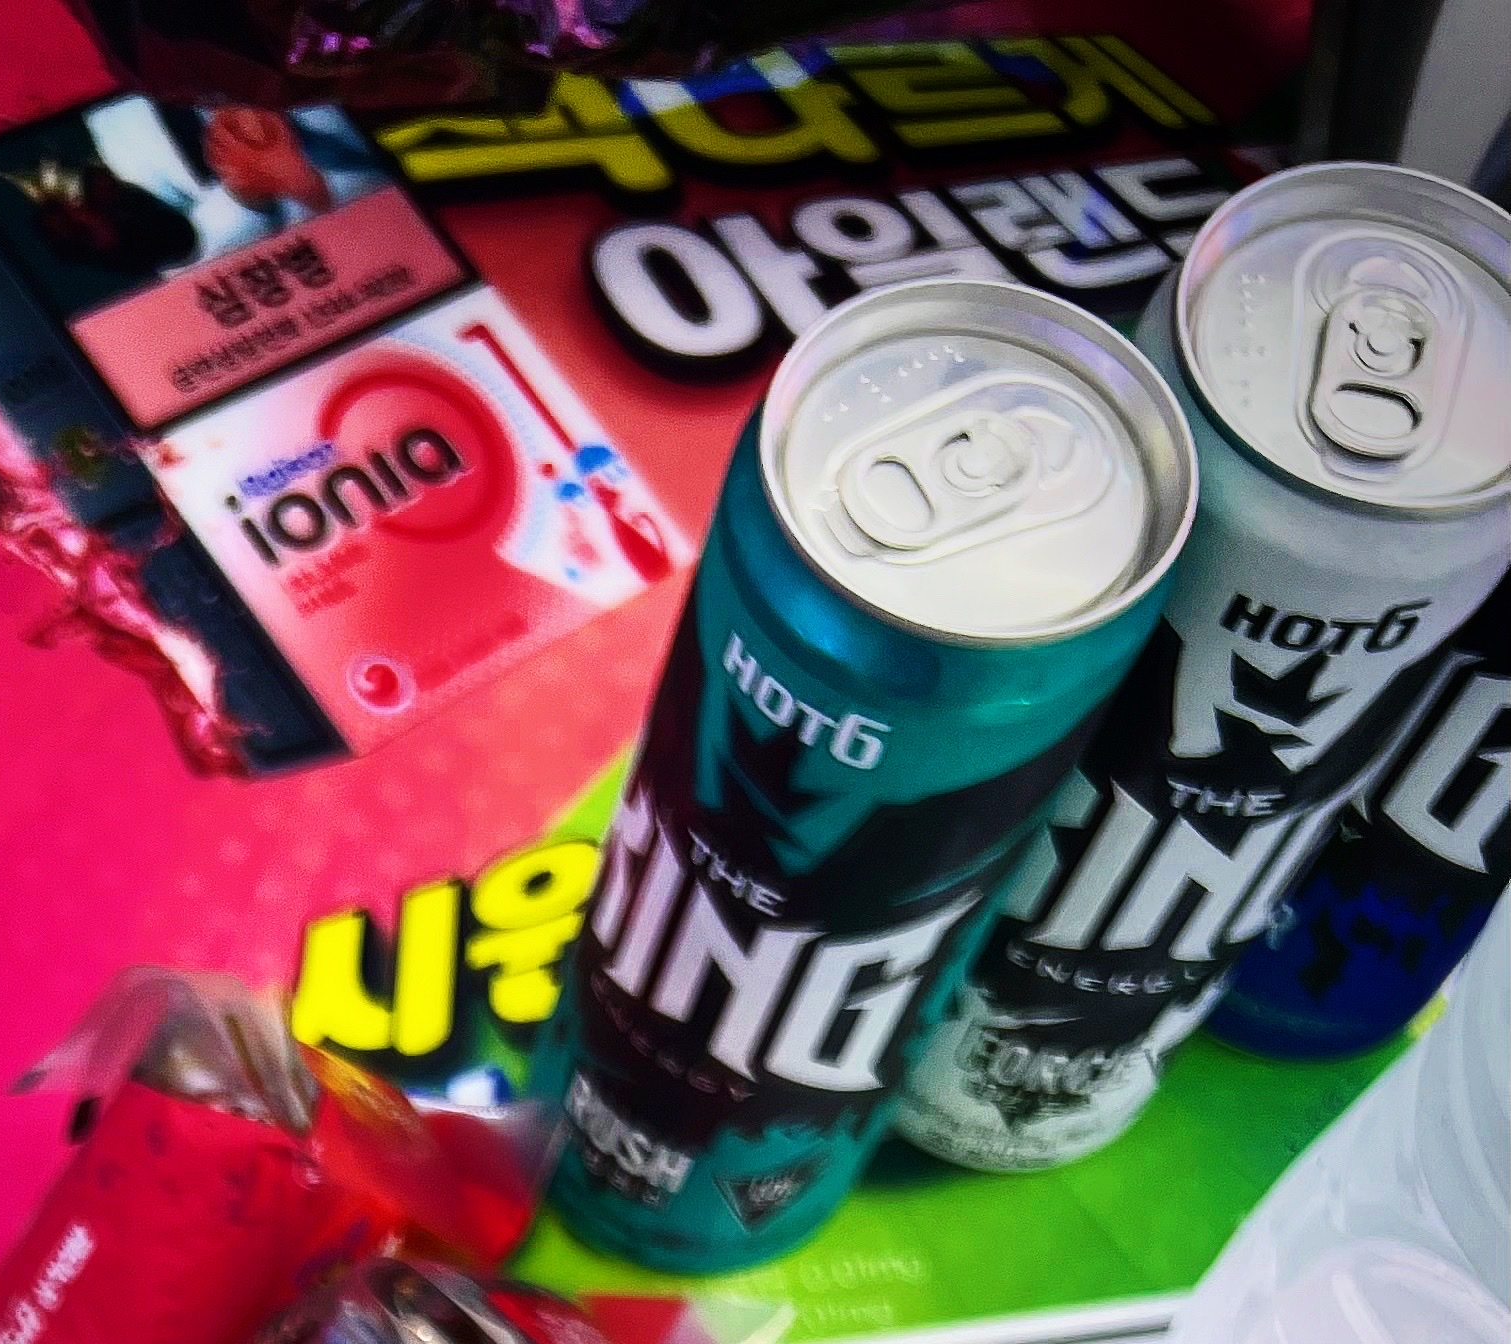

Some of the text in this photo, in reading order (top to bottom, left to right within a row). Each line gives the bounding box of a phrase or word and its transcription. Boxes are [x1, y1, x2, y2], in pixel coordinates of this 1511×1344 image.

[593, 157, 1236, 357] 아일랜드
[1166, 773, 1288, 819] THE
[687, 826, 788, 919] THE
